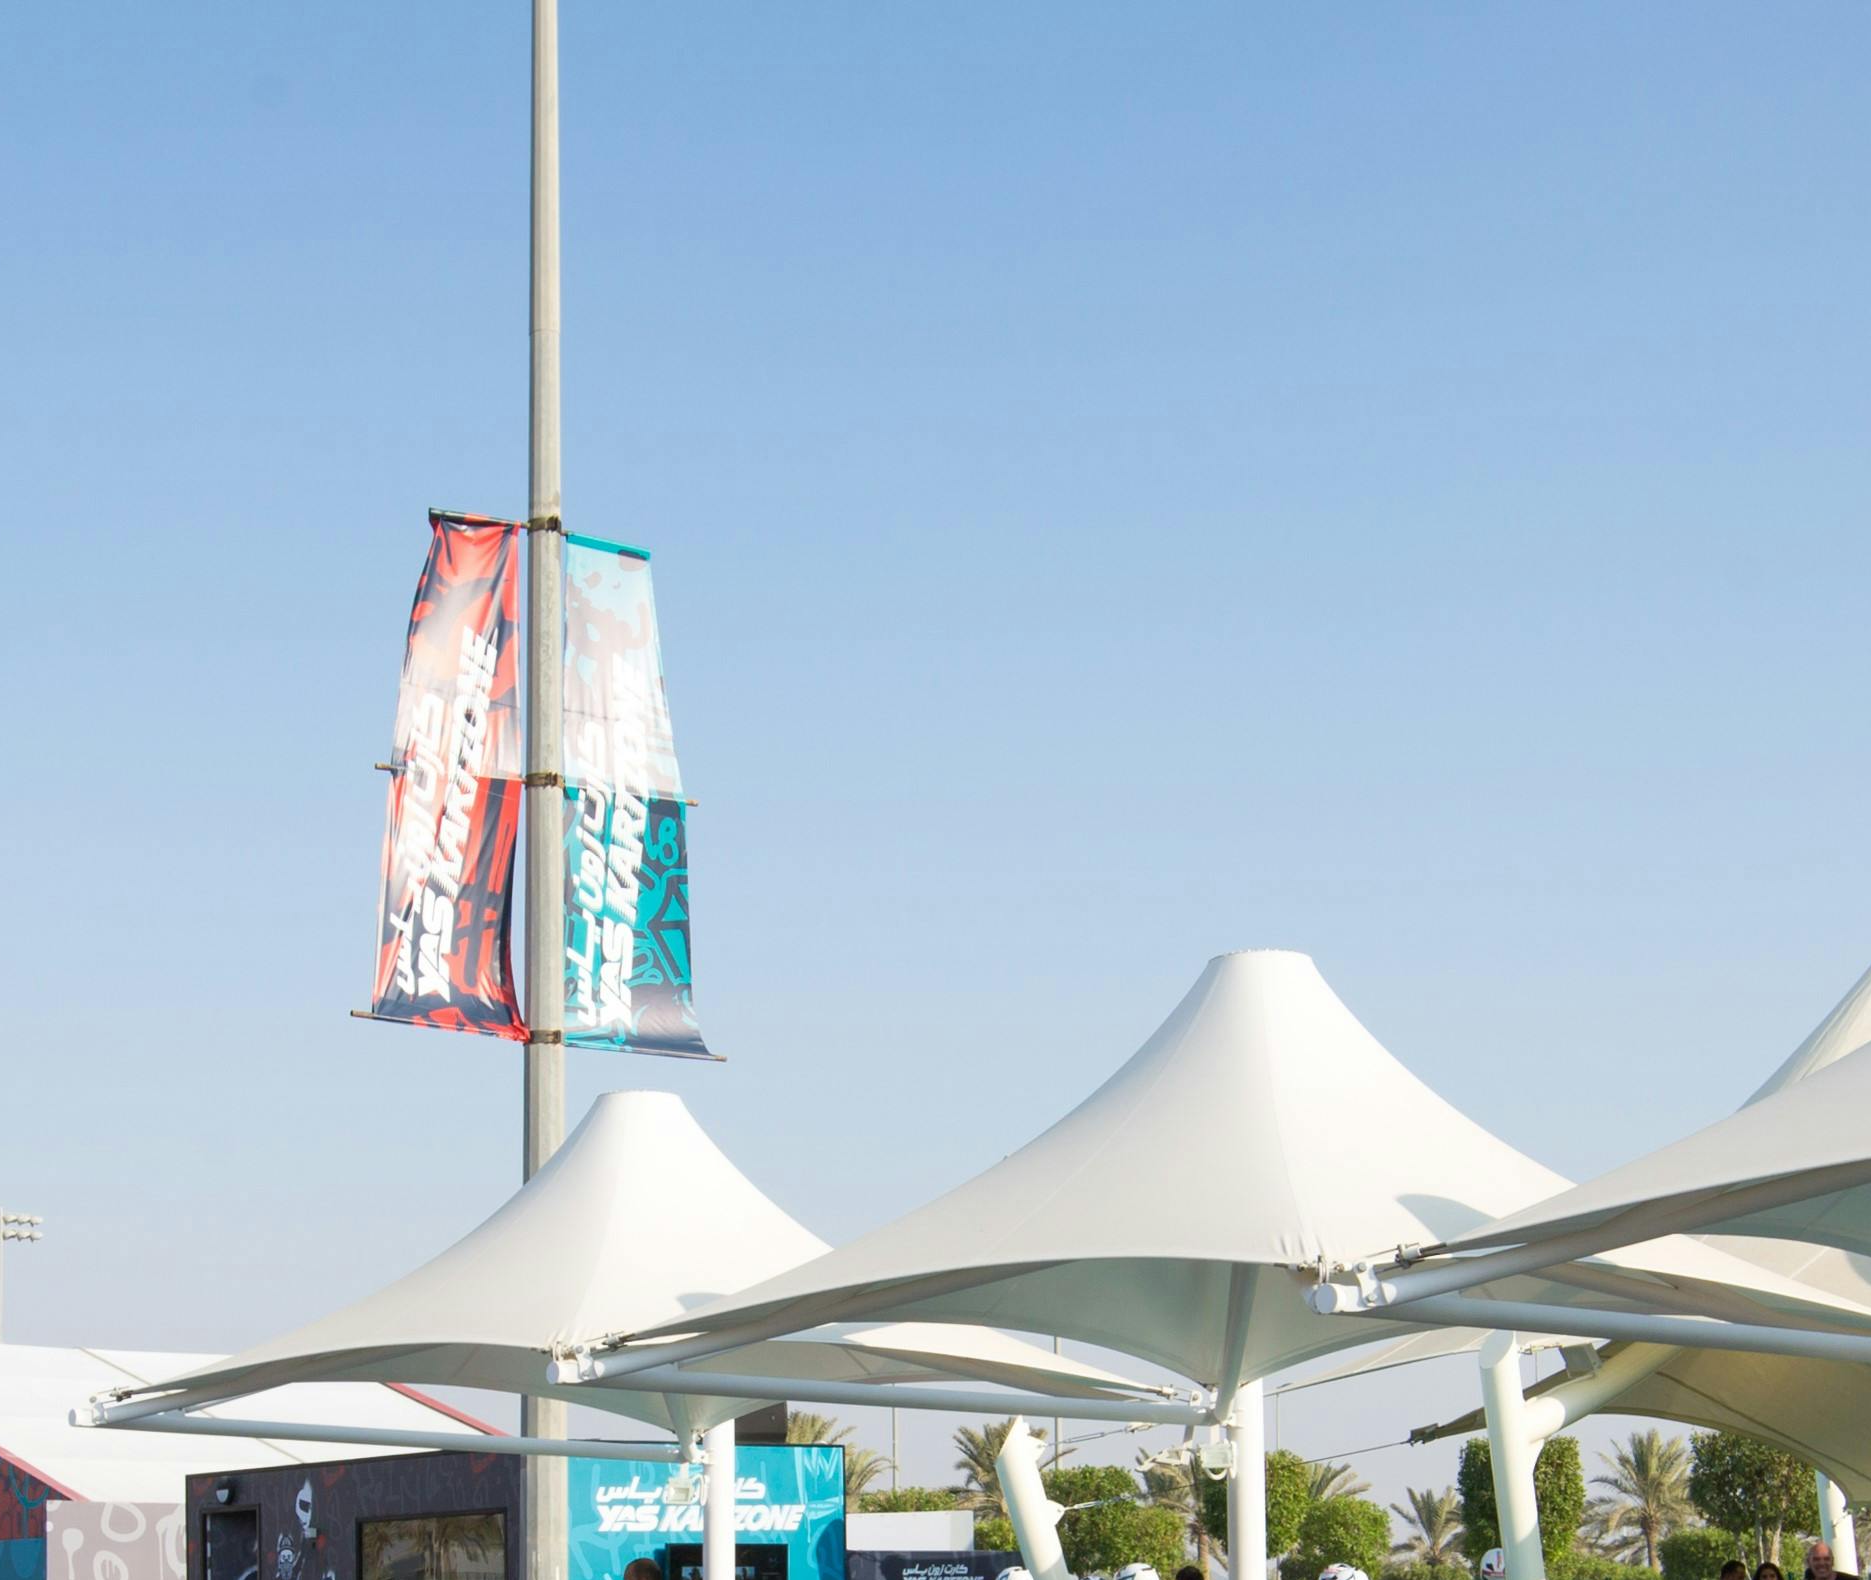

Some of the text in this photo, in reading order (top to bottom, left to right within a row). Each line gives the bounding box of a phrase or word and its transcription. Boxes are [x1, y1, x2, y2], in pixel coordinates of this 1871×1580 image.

[418, 886, 454, 1003] YAS
[600, 915, 633, 1028] YAS
[596, 1504, 805, 1532] YAS KAZONE
